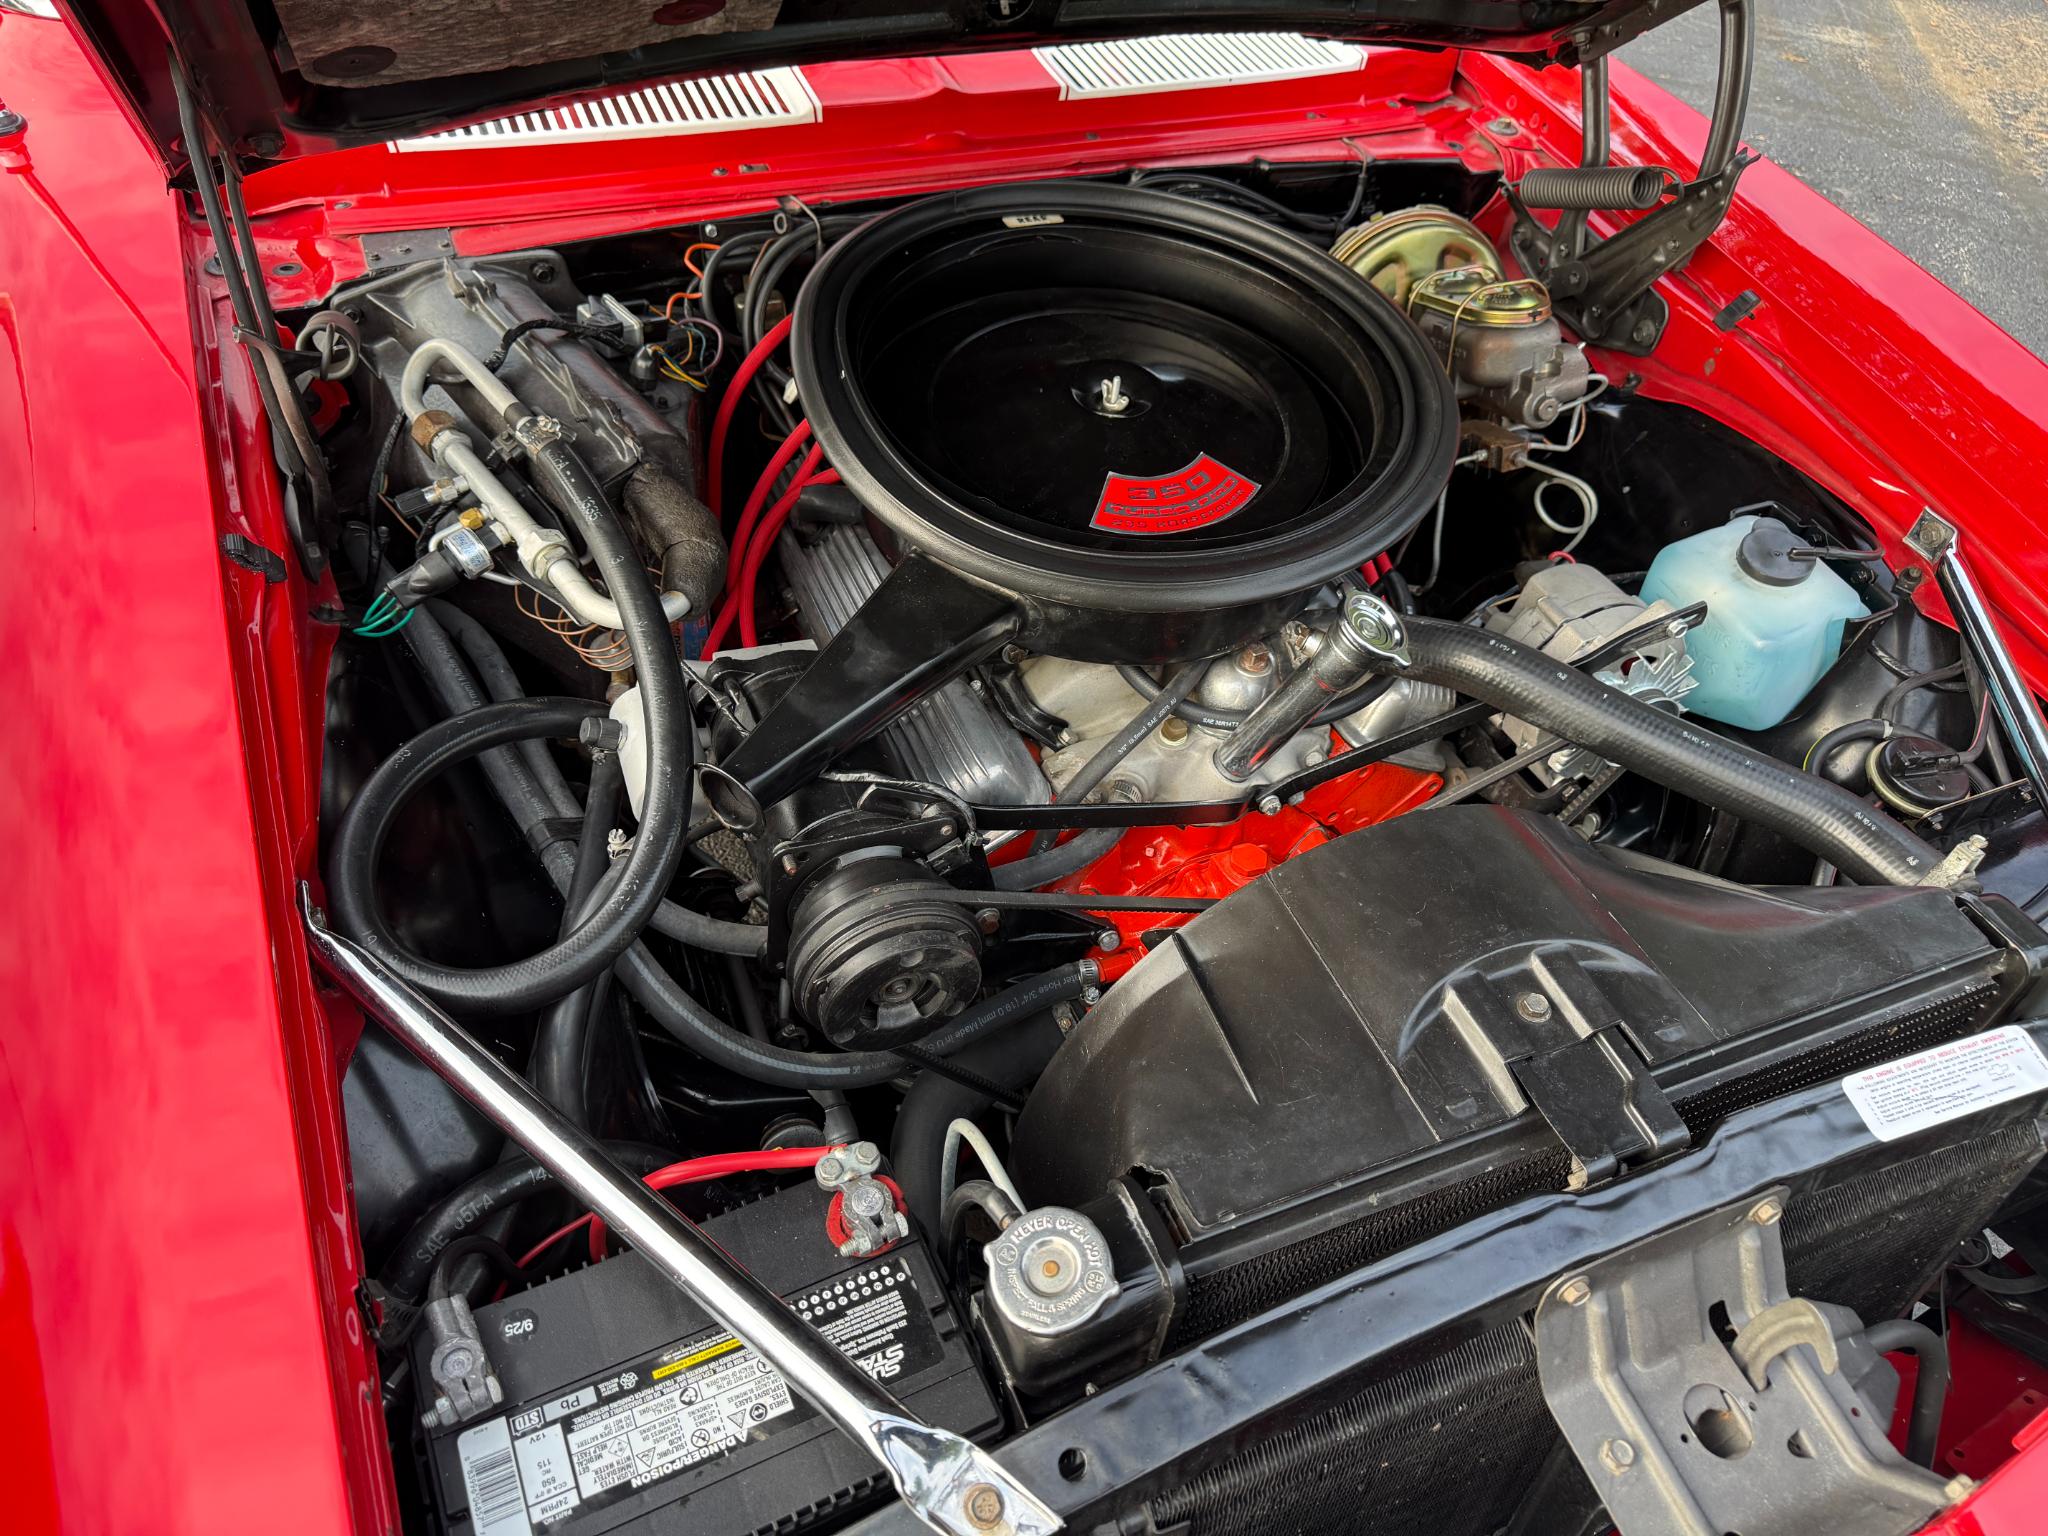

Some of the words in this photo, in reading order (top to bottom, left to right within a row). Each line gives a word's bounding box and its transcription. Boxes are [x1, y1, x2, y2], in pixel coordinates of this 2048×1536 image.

[1017, 215, 1046, 223] REAR
[1128, 471, 1210, 499] 350
[1157, 489, 1244, 528] HORSEPOWER
[1146, 716, 1158, 727] SAE
[1037, 978, 1062, 995] Hose
[953, 1020, 978, 1037] Made
[416, 1231, 450, 1263] SAE
[1010, 1216, 1052, 1244] NEVER
[1056, 1216, 1089, 1243] OPEN
[1084, 1242, 1103, 1267] HOT
[1057, 1288, 1086, 1311] SPRING
[503, 1317, 534, 1336] 9/25
[699, 1345, 724, 1358] WARRANTY
[687, 1355, 699, 1363] CALL
[737, 1363, 754, 1374] REACH
[743, 1370, 756, 1379] KEEP
[752, 1382, 784, 1400] EXPLOSIVE
[754, 1381, 770, 1391] CAUSE
[726, 1387, 754, 1403] BLINDNESS
[733, 1395, 753, 1408] GASES
[769, 1389, 786, 1402] EYES.
[559, 1394, 581, 1411] Pb
[609, 1397, 643, 1416] DISASSEMBLE
[768, 1396, 789, 1410] SHIELD
[622, 1414, 631, 1422] DO
[652, 1408, 662, 1416] ALL
[512, 1410, 541, 1431] STD
[611, 1417, 623, 1426] NOT
[625, 1420, 633, 1428] DO
[656, 1415, 676, 1428] SEVERE
[598, 1428, 614, 1439] OPEN
[613, 1423, 625, 1432] NOT
[649, 1422, 679, 1438] BLINDNESS
[668, 1428, 680, 1437] CAN
[711, 1425, 721, 1434] NO
[527, 1431, 546, 1444] 12V
[574, 1434, 599, 1448] BATTERY.
[640, 1433, 650, 1442] OR
[651, 1433, 669, 1444] CAUSE
[667, 1435, 682, 1445] ACID
[591, 1442, 608, 1454] HELP
[655, 1442, 685, 1459] SULFURIC
[573, 1449, 591, 1461] FAST.
[575, 1452, 603, 1468] MEDICAL
[614, 1454, 631, 1466] WITH
[630, 1435, 736, 1488] DANGER/POISON
[535, 1456, 552, 1469] 115
[591, 1461, 615, 1476] WATER.
[576, 1465, 590, 1475] GET
[591, 1462, 634, 1484] IMMEDIATELY
[615, 1468, 636, 1481] FLUSH
[540, 1475, 557, 1488] 650
[551, 1480, 567, 1491] CCA
[598, 1476, 616, 1488] EYES
[538, 1496, 569, 1514] 24PRM
